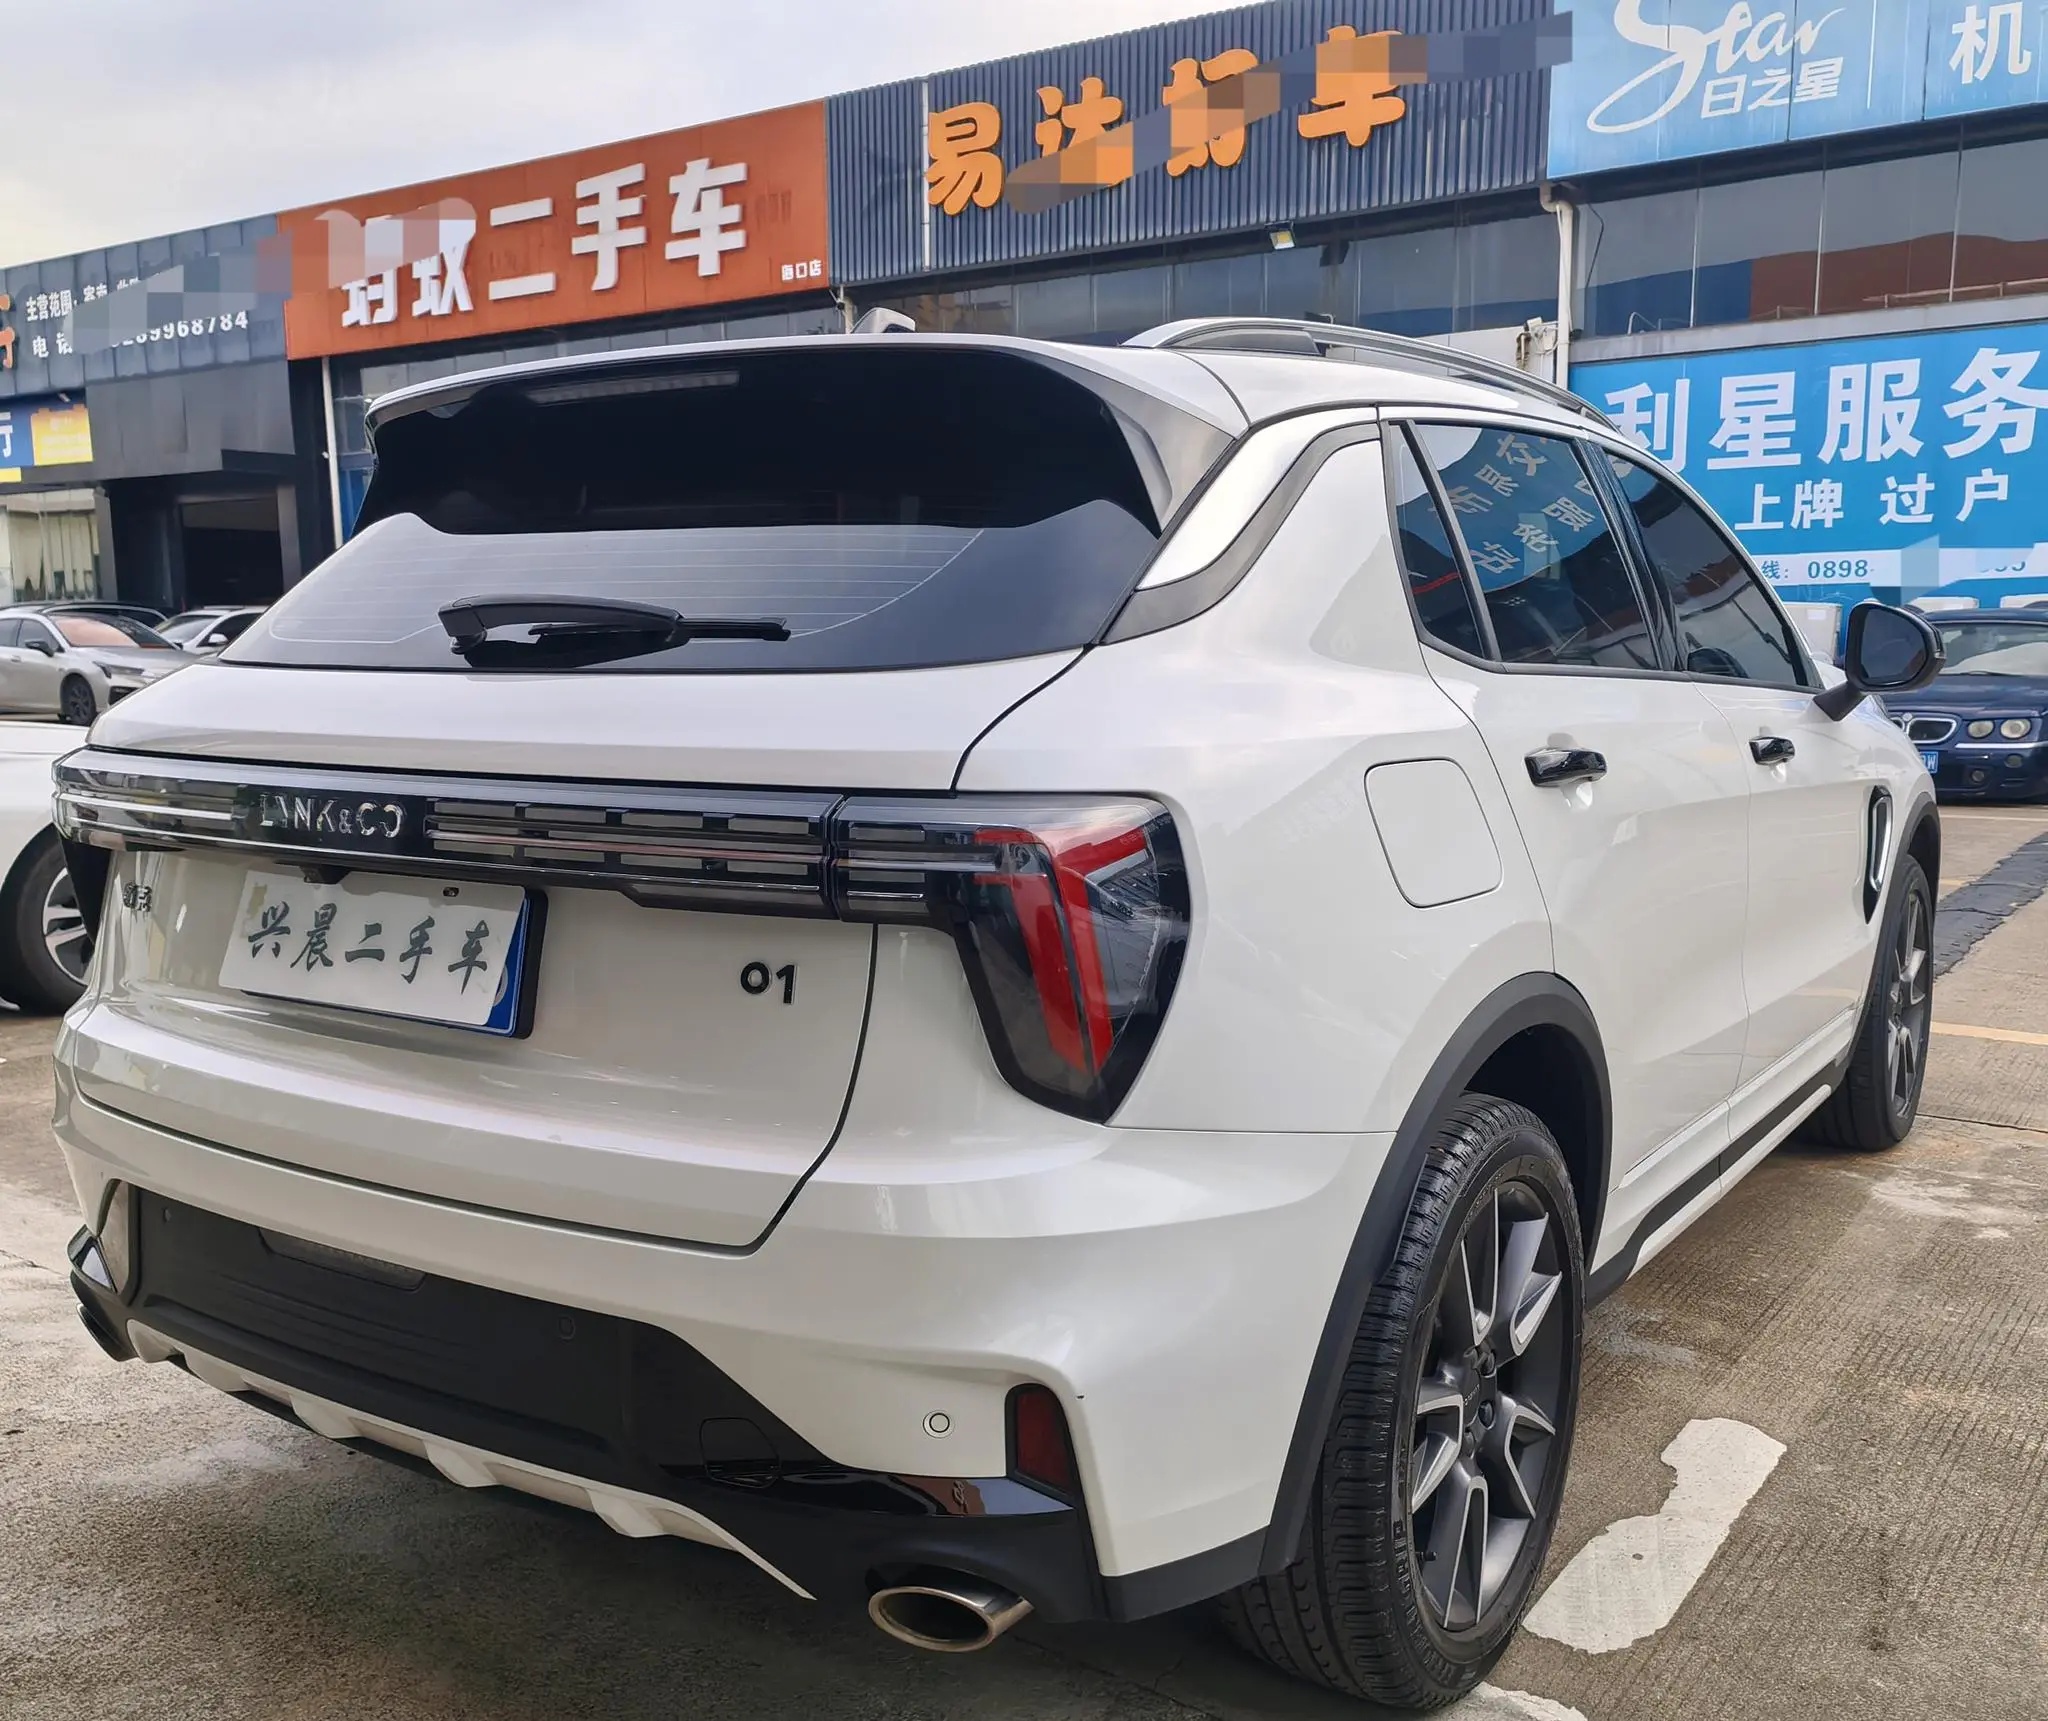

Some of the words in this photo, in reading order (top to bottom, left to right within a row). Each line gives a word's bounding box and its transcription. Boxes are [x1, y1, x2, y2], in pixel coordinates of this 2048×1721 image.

[1587, 0, 1846, 133] Star
[1701, 57, 1845, 119] 日之星
[1604, 347, 2048, 474] 利星服务
[247, 900, 489, 995] 兴晨二手车
